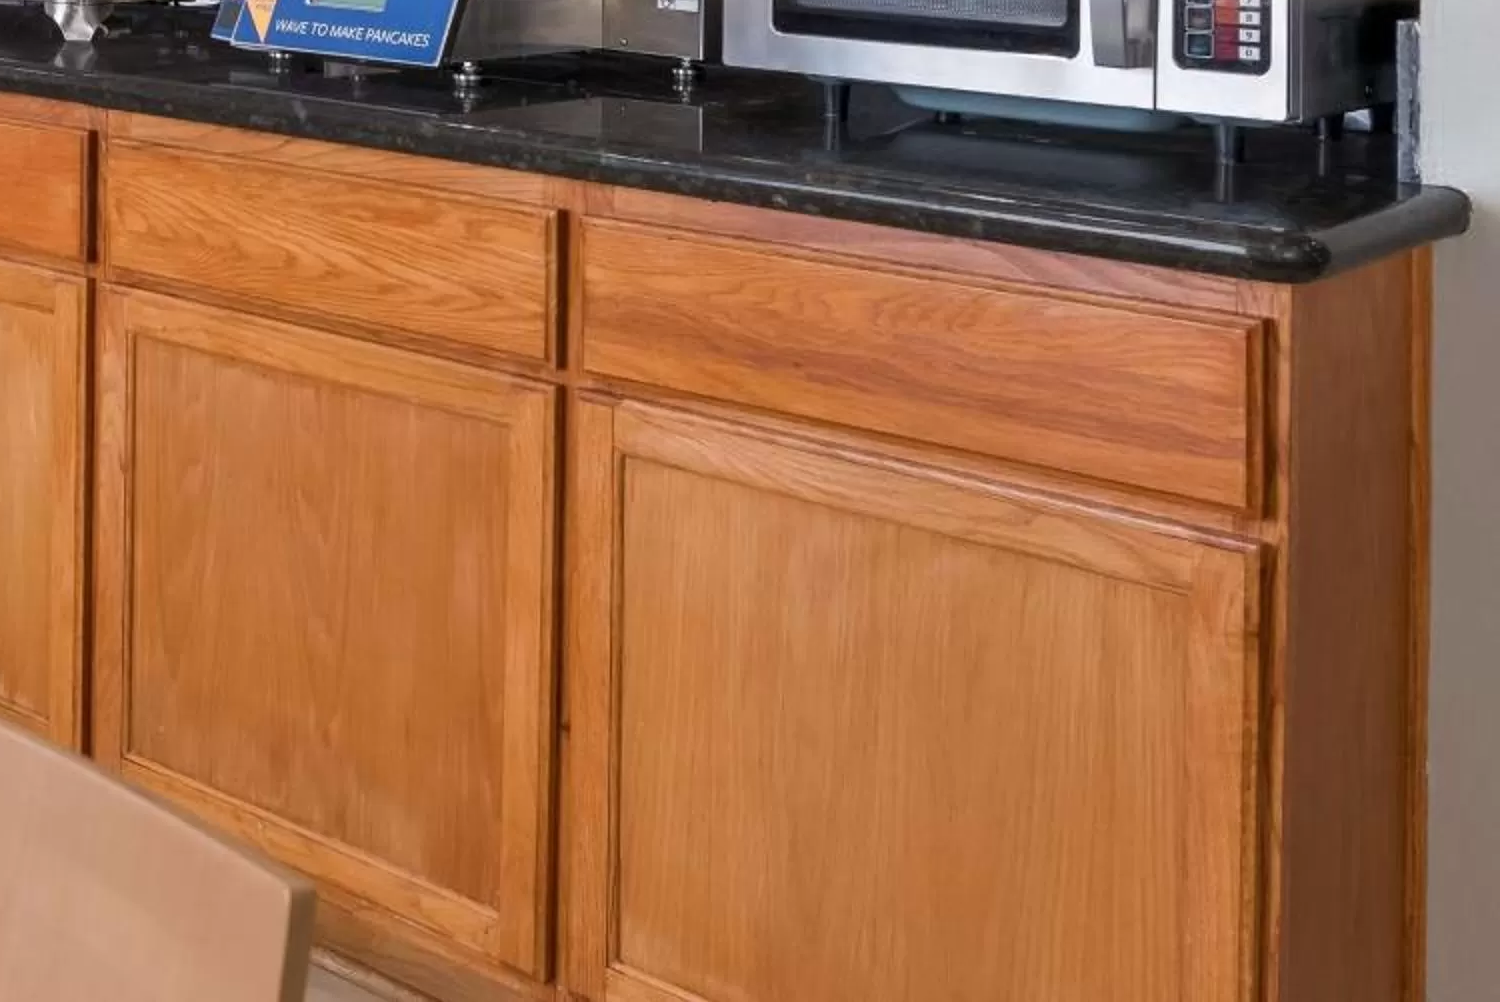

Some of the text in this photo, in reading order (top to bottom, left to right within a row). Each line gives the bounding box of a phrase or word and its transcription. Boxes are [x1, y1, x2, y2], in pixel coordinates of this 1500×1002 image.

[275, 19, 431, 48] WAVE TO MAKE PANCAKES
